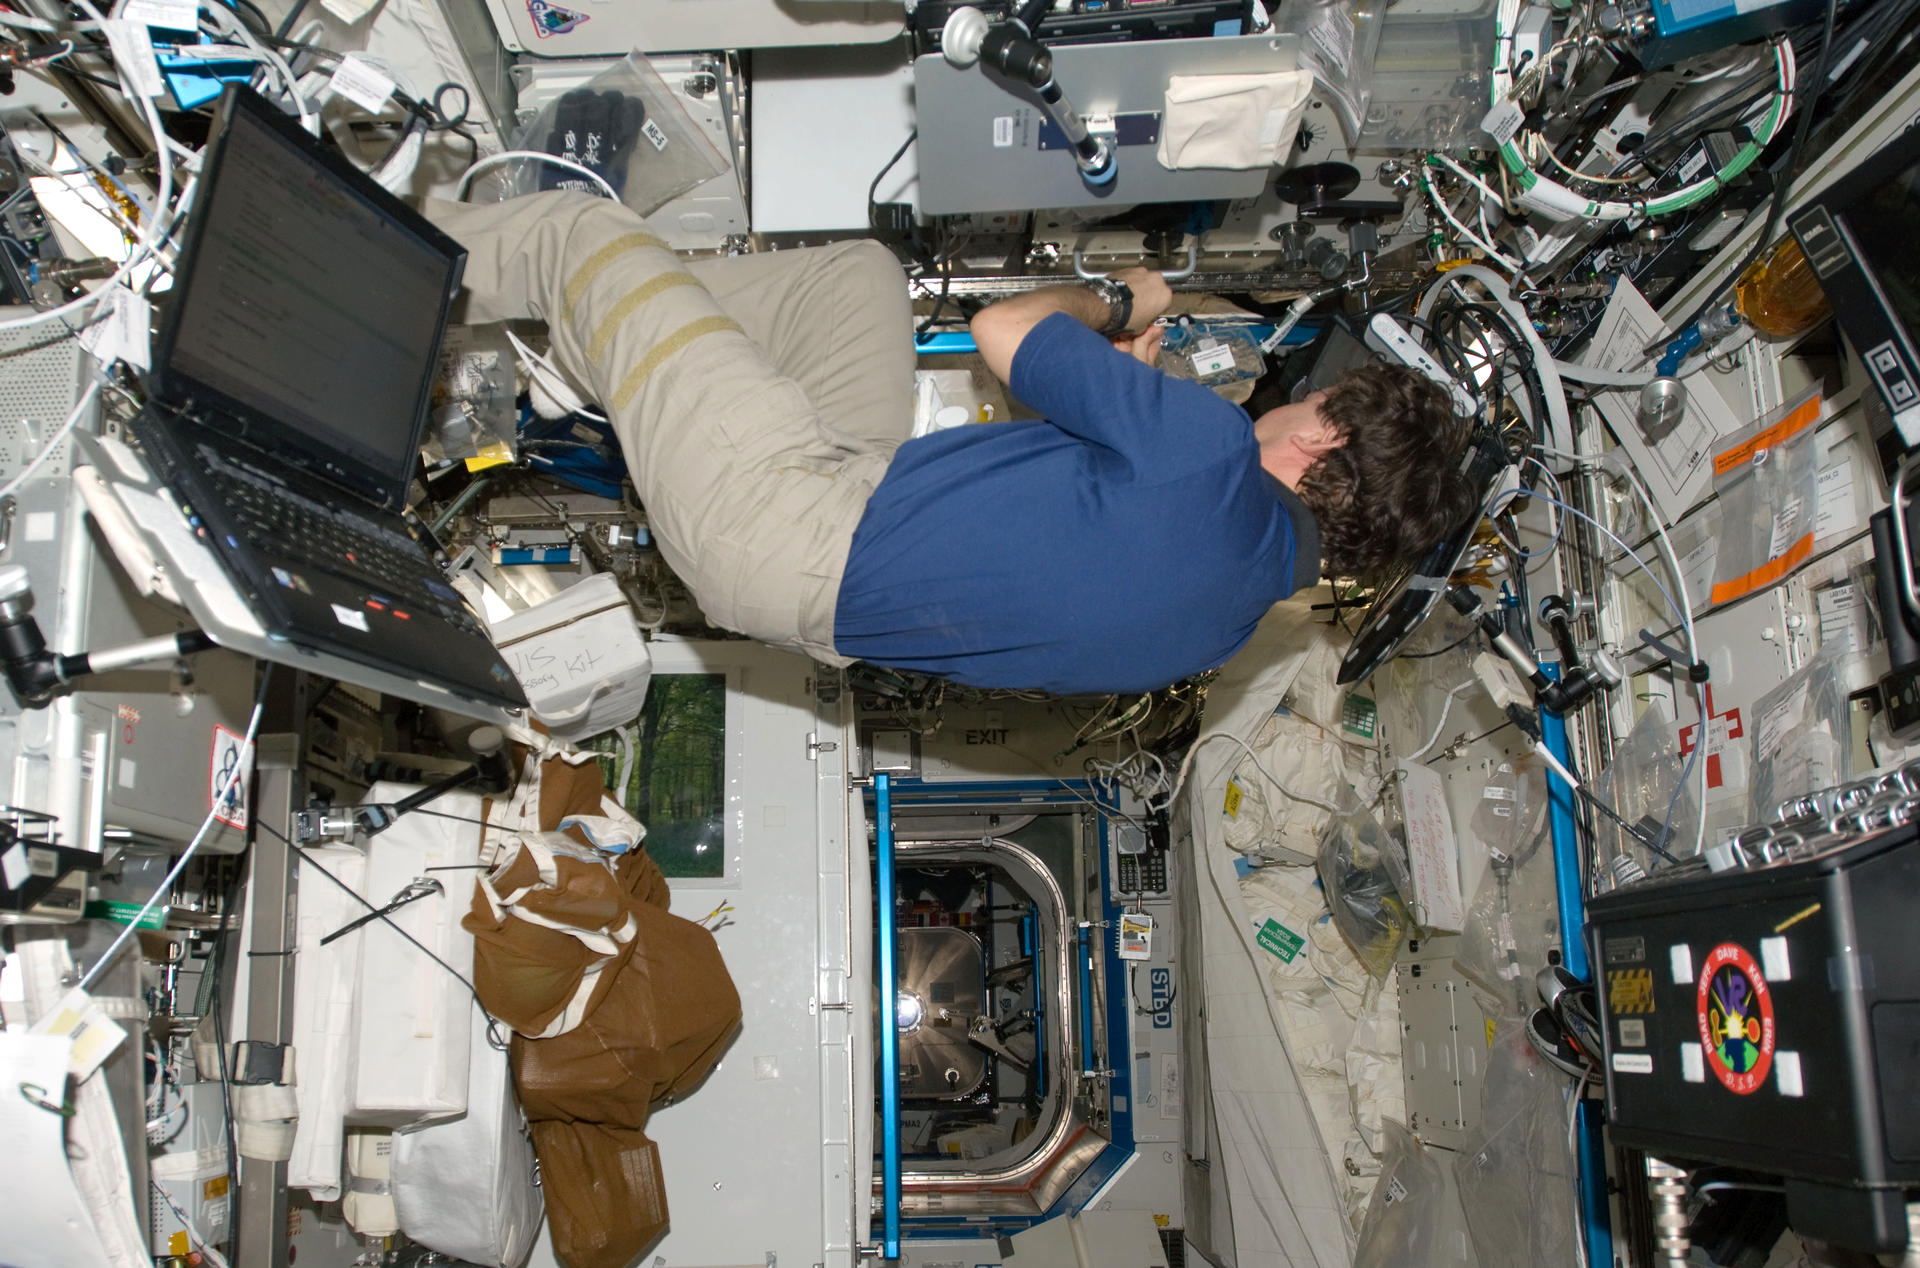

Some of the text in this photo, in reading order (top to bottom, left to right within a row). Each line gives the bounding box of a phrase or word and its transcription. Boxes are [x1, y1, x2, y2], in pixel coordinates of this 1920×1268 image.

[646, 123, 665, 146] MS-5
[1667, 153, 1691, 178] 120 VDC
[564, 649, 604, 680] Kit
[966, 728, 1010, 745] EXIT
[1260, 935, 1290, 960] TECHNICAL
[1152, 970, 1170, 1025] STBD
[1699, 947, 1772, 1055] BRAD JEFF DAVE KEN ERIN
[1715, 974, 1748, 1017] VR
[901, 1119, 921, 1128] PMA2
